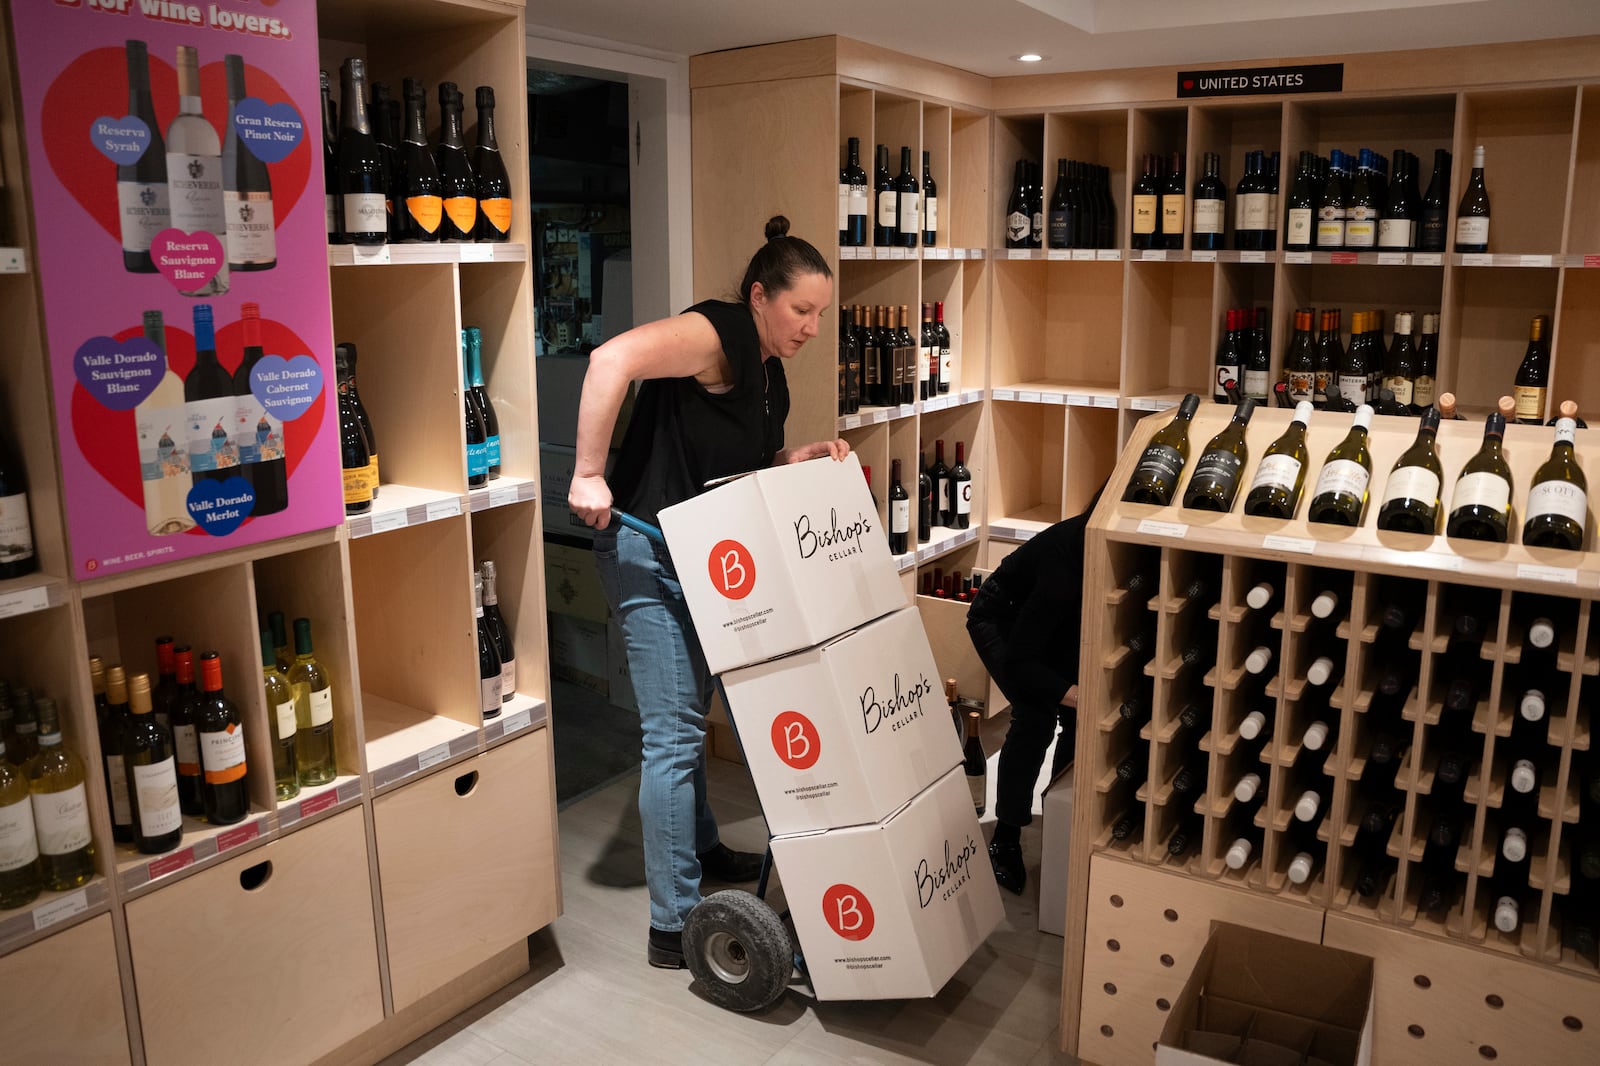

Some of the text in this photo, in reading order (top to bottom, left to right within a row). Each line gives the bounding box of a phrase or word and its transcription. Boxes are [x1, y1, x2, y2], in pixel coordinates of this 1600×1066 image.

[140, 0, 201, 24] wine
[209, 5, 289, 36] lovers.
[1200, 74, 1304, 90] UNITED STATES
[235, 114, 302, 130] Gran Reserva
[98, 124, 145, 139] Reserva
[244, 129, 296, 142] Pinot Noir
[105, 140, 140, 153] Syrah
[166, 241, 209, 251] Reserva
[160, 256, 216, 267] Sauvignon
[174, 270, 205, 279] Blanc
[82, 352, 157, 367] Valle Dorado
[91, 367, 152, 382] Sauvignon
[256, 368, 316, 382] Valle Dorado
[107, 382, 140, 394] Blanc
[266, 382, 309, 394] Cabernet
[264, 394, 313, 408] Sauvignon
[189, 493, 253, 513] Valle Dorado
[206, 509, 240, 523] Merlot
[793, 508, 872, 559] Bishop's
[829, 546, 856, 562] CELLAR
[720, 550, 746, 591] B
[723, 608, 774, 628] www.bishopscellar.com
[860, 673, 932, 735] Bishop's
[892, 711, 918, 732] CELLAR
[784, 721, 810, 760] B
[784, 782, 838, 794] www.bishopscellar.com
[914, 835, 977, 908] Bishop's
[942, 877, 966, 901] CELLAR
[836, 895, 864, 931] B
